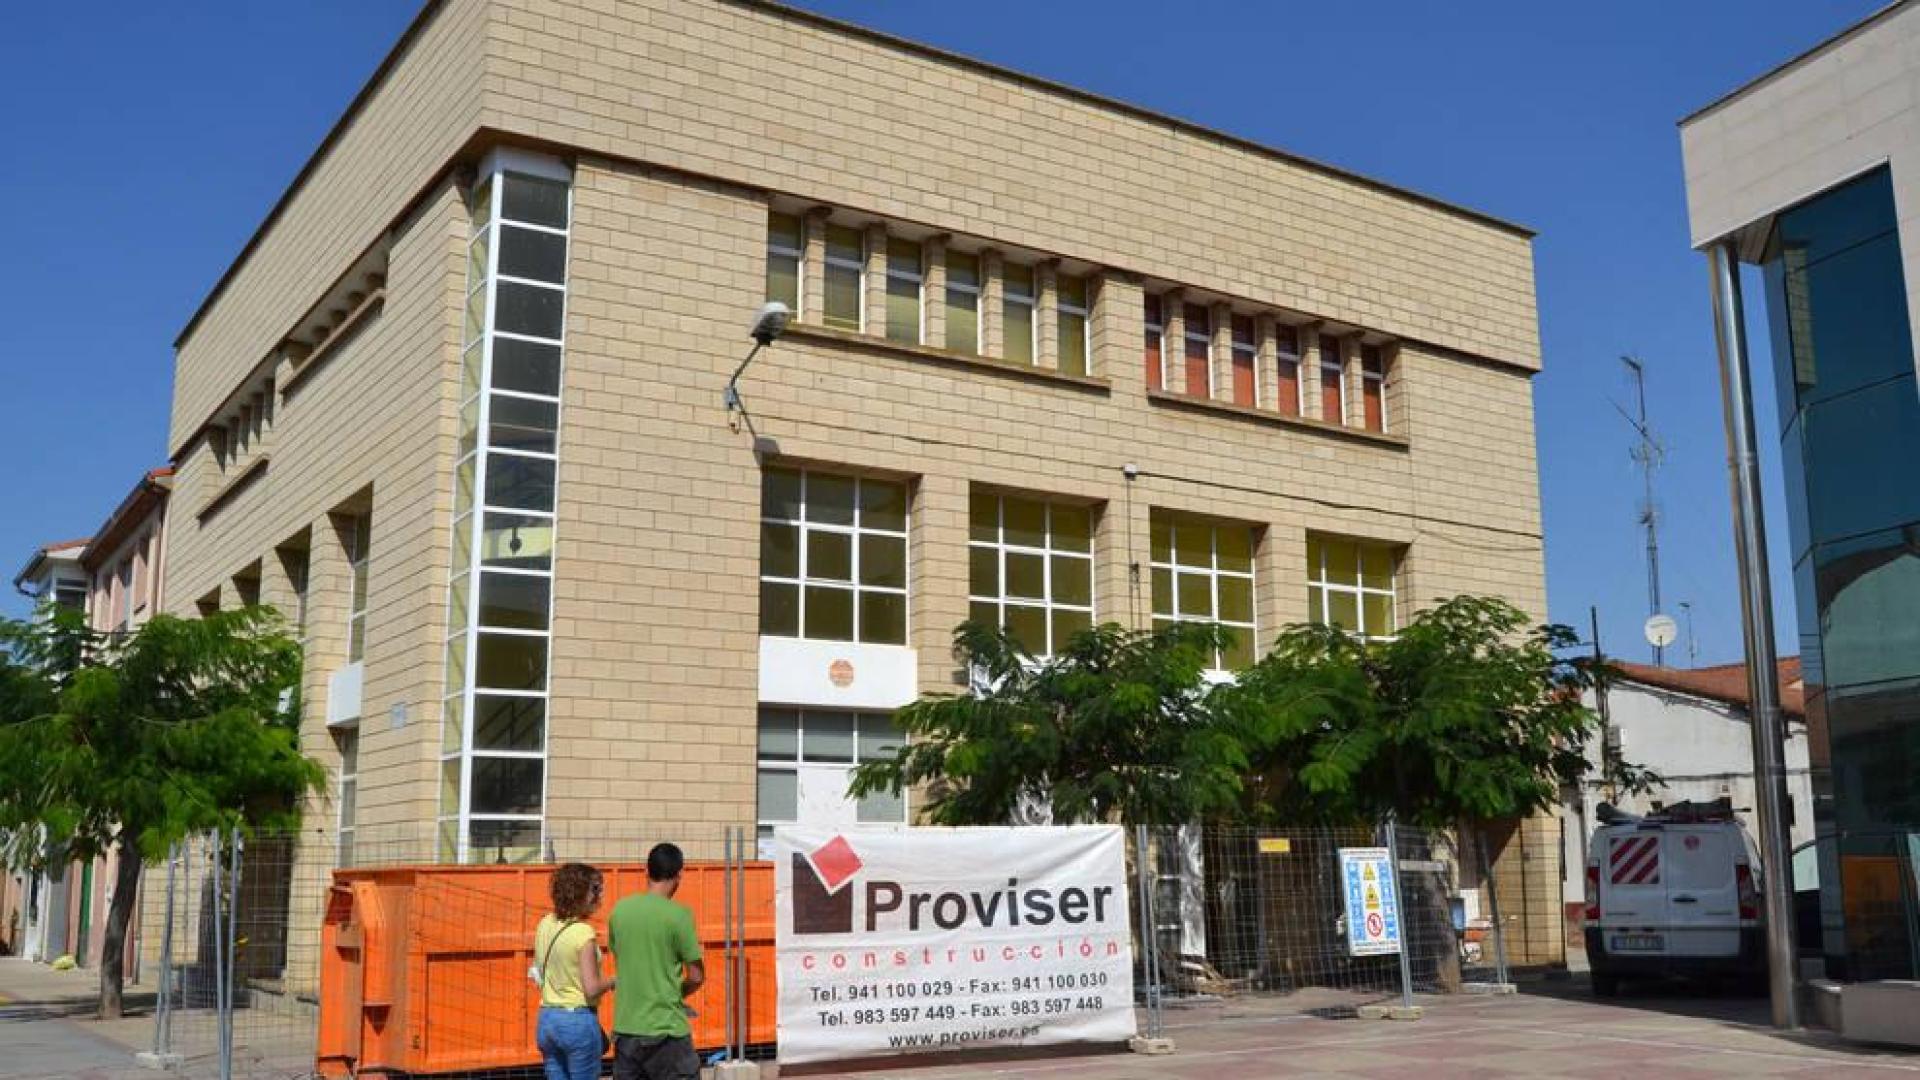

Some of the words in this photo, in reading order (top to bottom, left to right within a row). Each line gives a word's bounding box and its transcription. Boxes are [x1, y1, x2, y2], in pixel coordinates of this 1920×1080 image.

[865, 878, 1113, 932] Proviser
[802, 938, 1119, 970] construcción
[811, 986, 842, 1001] Tel.
[849, 984, 878, 1000] 941
[886, 982, 916, 998] 100
[922, 980, 953, 996] 029
[969, 978, 1007, 994] Fax:
[1012, 976, 1040, 991] 941
[1048, 974, 1075, 989] 100
[1080, 971, 1107, 987] 030
[819, 1010, 849, 1027] Tel.
[854, 1009, 885, 1025] 983
[890, 1007, 919, 1022] 597
[924, 1005, 955, 1020] 449
[971, 1003, 1007, 1017] Fax:
[1010, 1000, 1040, 1015] 983
[1044, 998, 1071, 1013] 597
[1076, 996, 1103, 1010] 448
